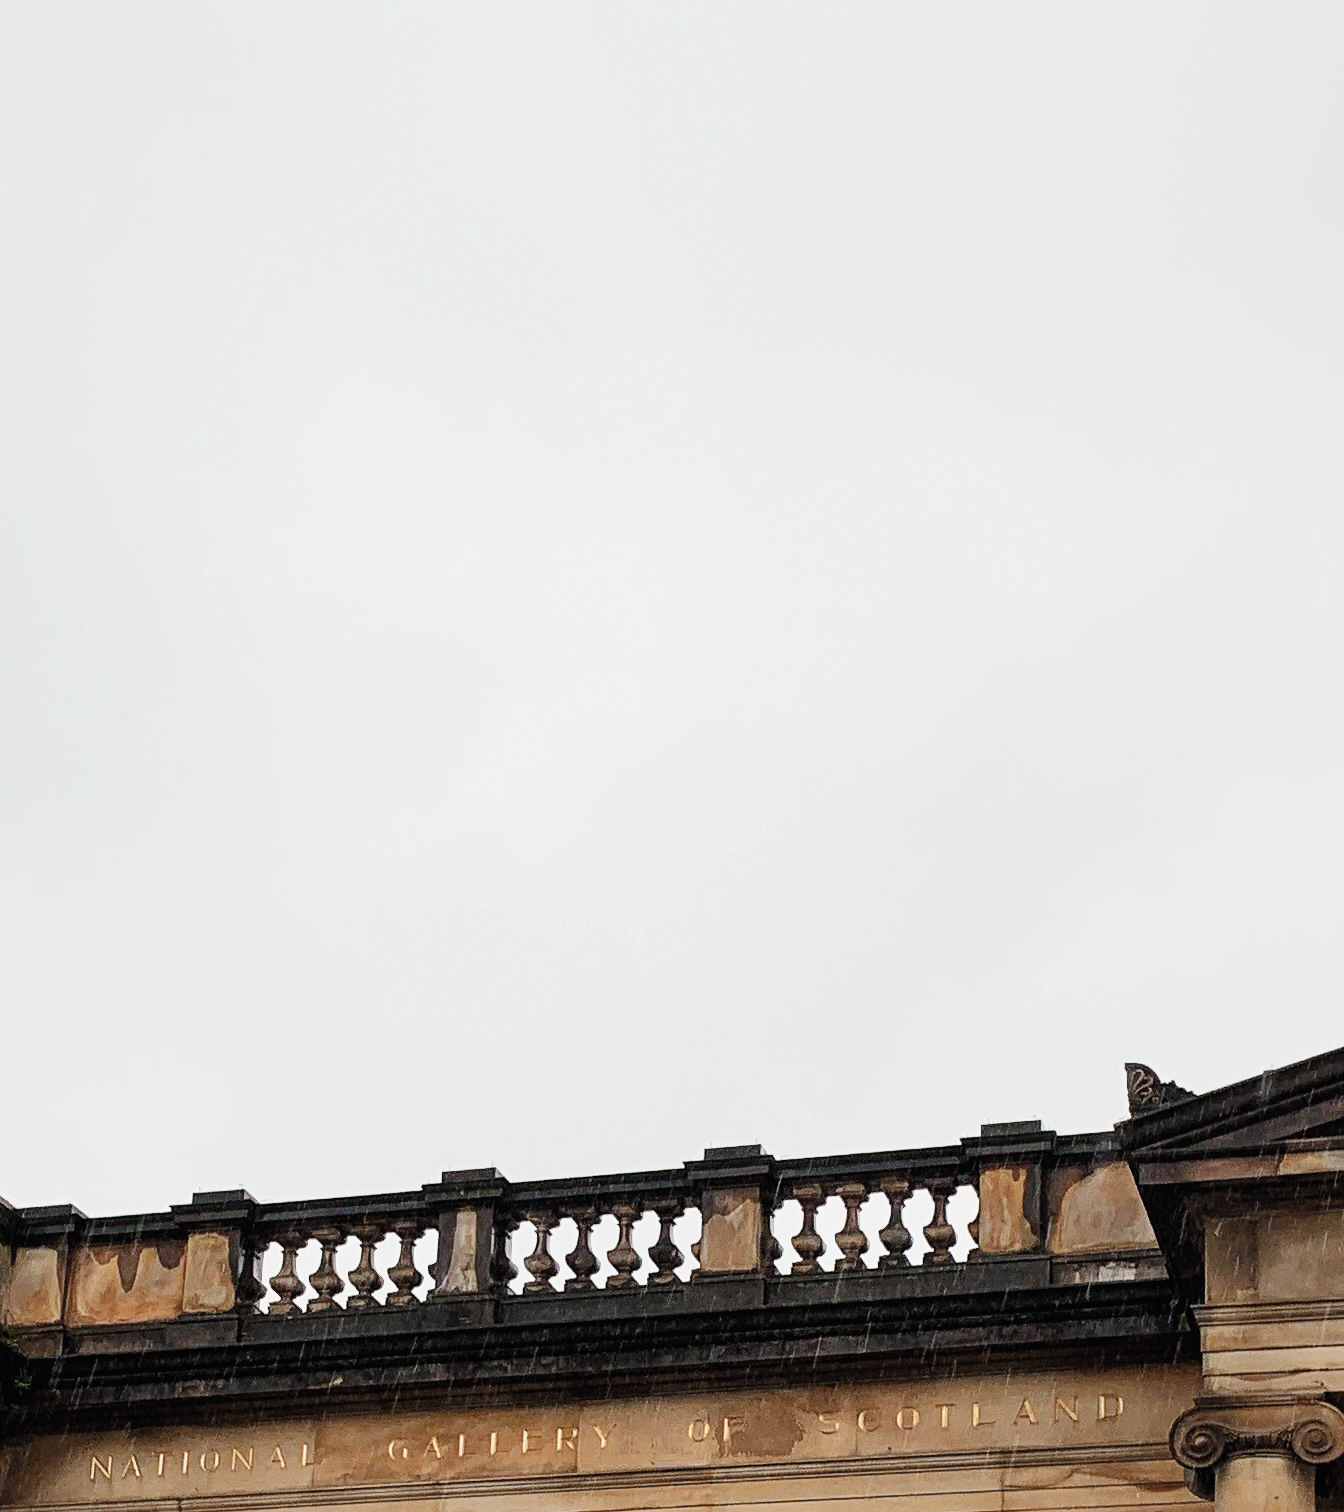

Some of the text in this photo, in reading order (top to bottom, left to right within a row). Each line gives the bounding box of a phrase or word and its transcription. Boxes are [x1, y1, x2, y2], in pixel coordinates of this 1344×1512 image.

[89, 1393, 1125, 1481] NATIONAL GALLERY OF SCOTLAND
